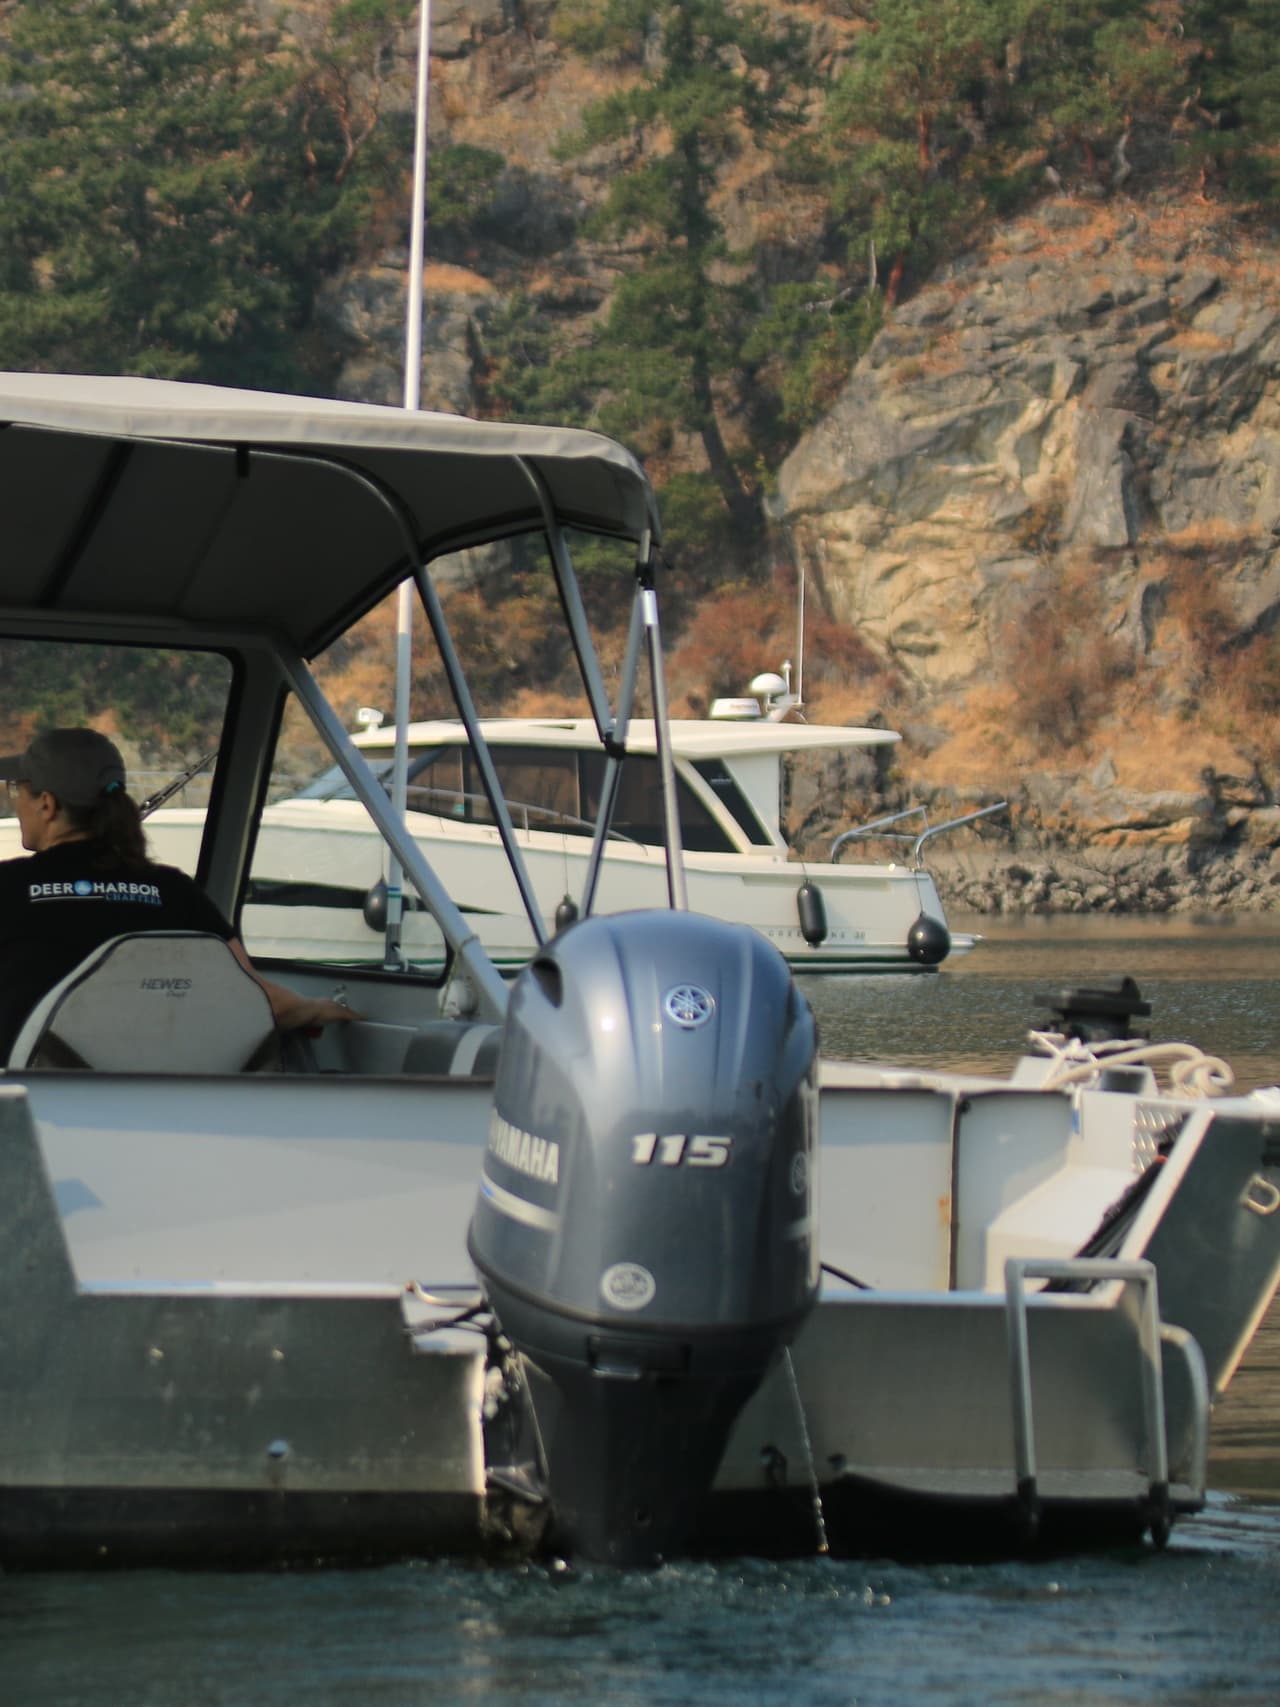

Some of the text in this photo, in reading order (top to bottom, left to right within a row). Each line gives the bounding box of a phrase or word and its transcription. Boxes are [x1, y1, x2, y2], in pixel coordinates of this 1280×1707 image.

[30, 882, 160, 897] DEER HARBOR
[141, 977, 193, 990] HEWES
[495, 1114, 559, 1185] YAMAHA
[632, 1133, 732, 1167] 115
